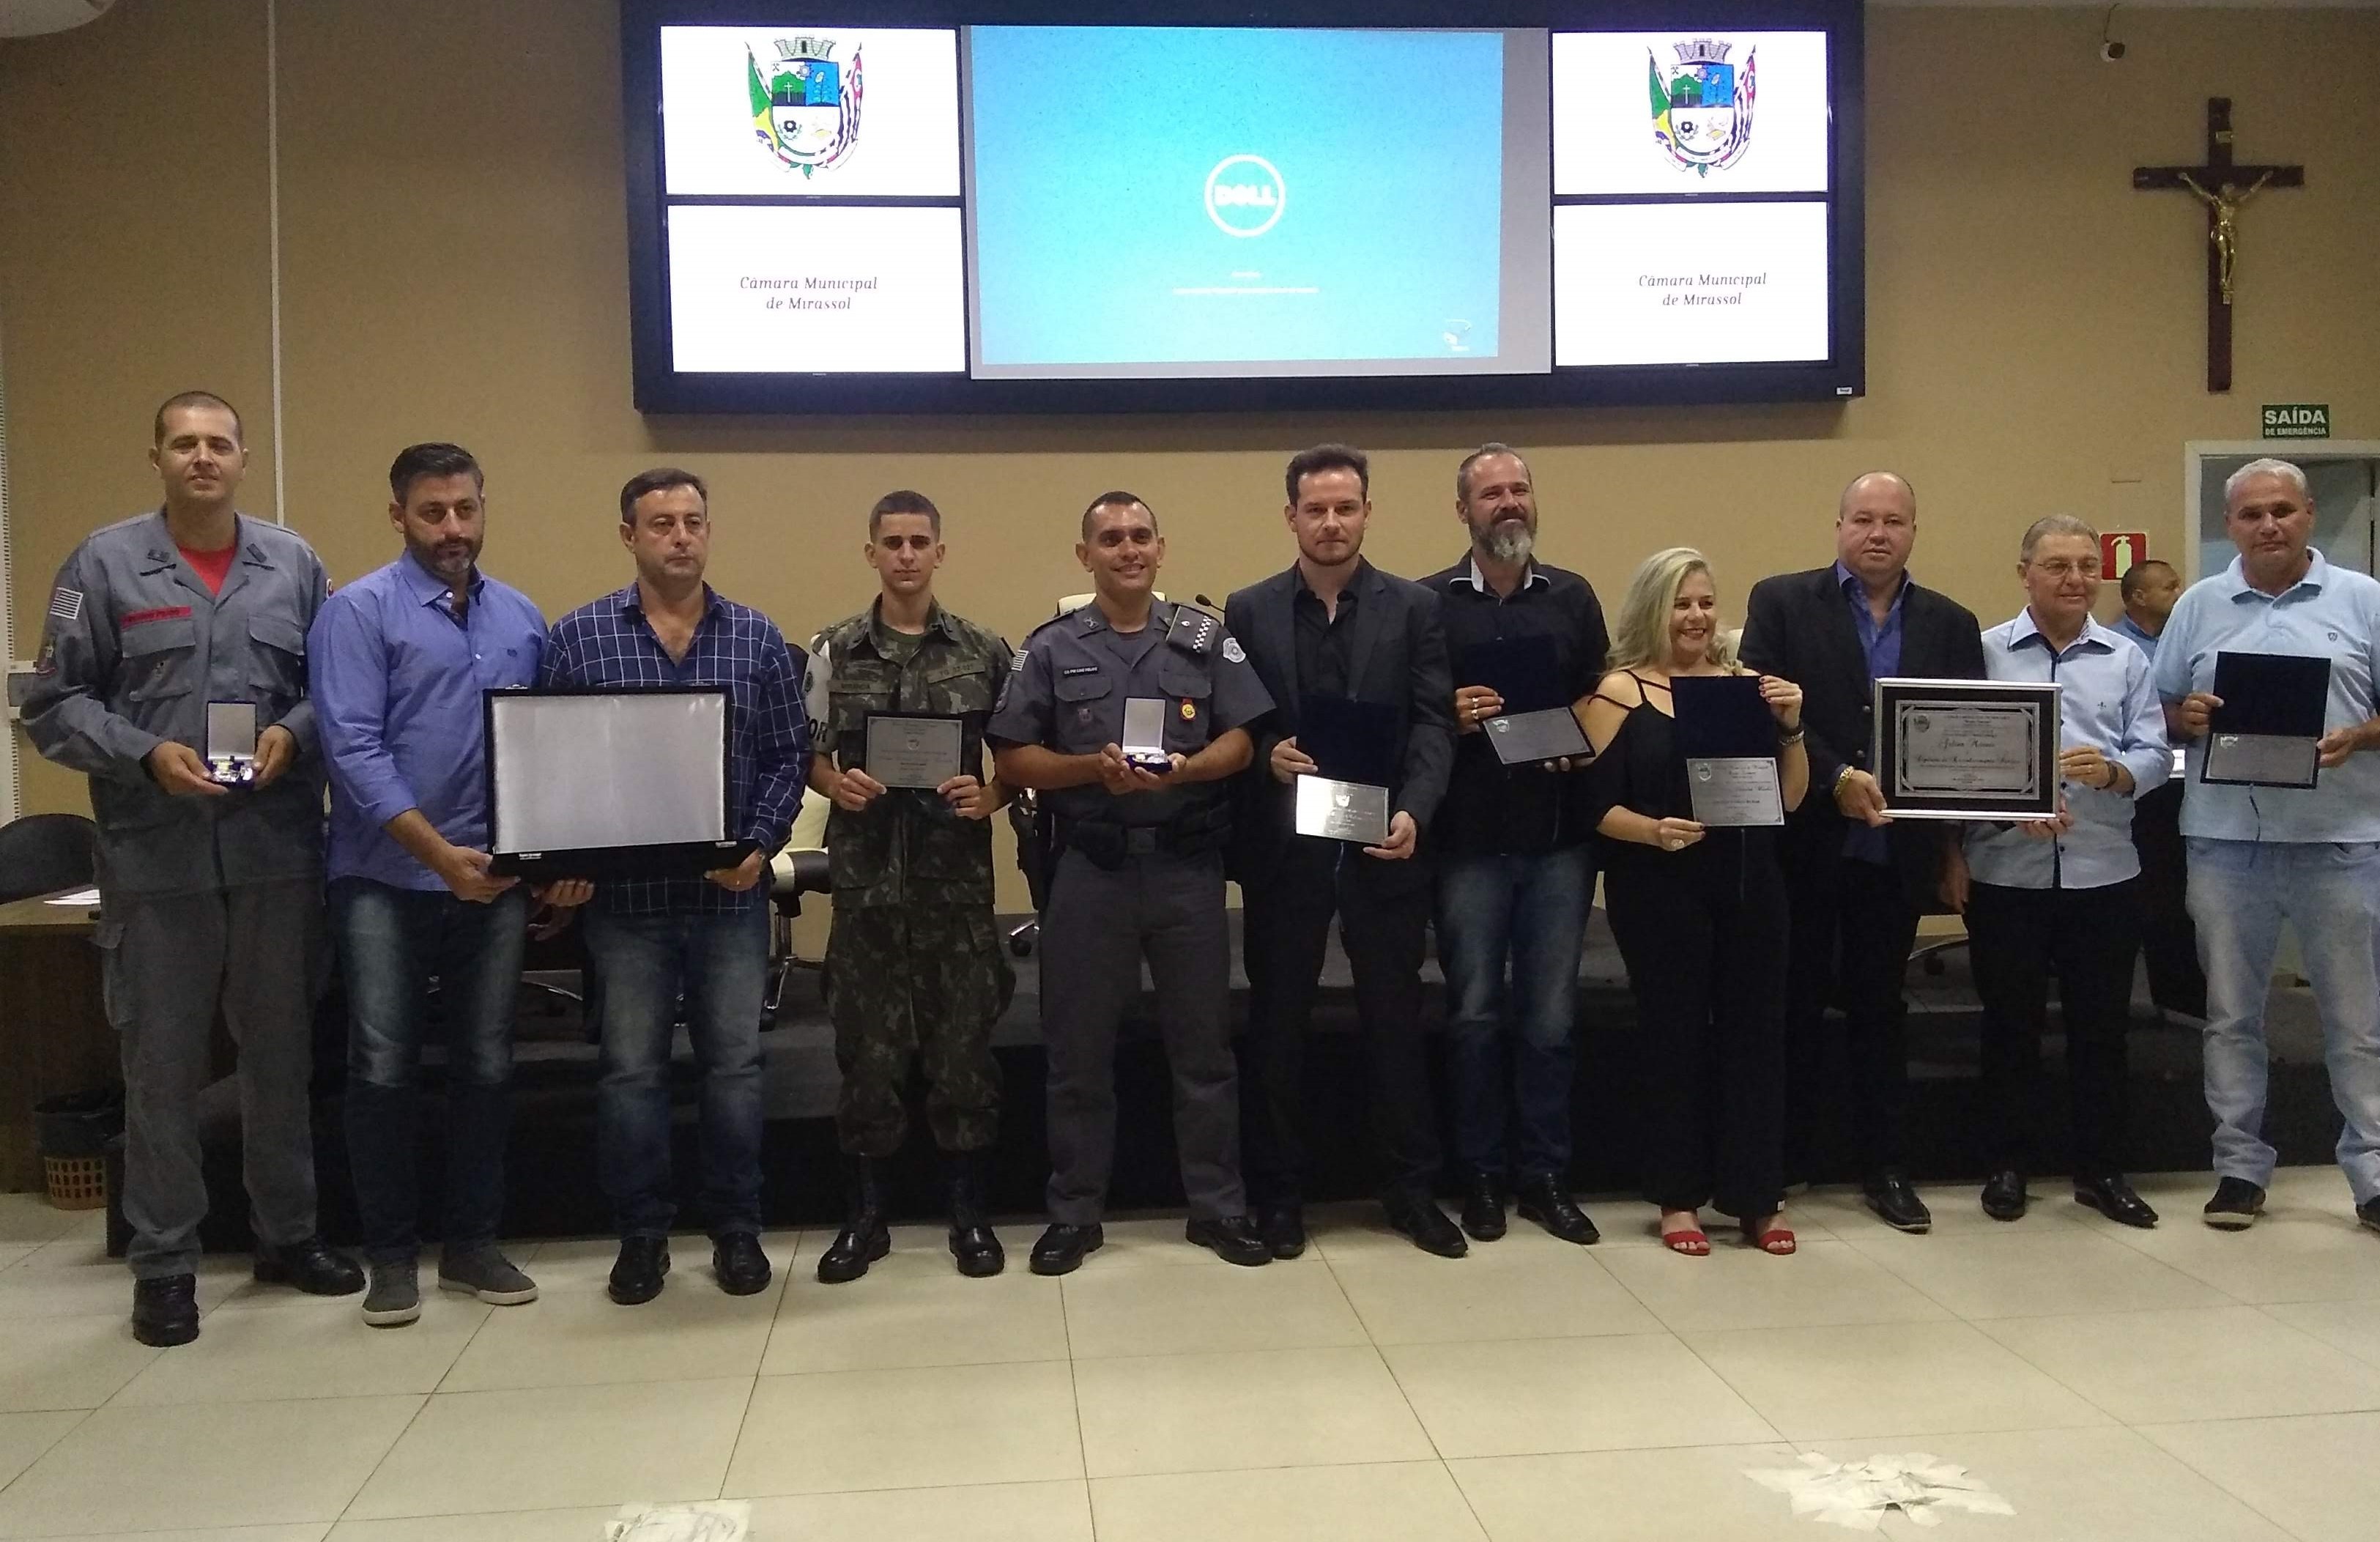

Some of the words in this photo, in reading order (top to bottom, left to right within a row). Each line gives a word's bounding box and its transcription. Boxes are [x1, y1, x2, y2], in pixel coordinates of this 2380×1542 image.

[740, 276, 798, 289] Câmara
[804, 276, 877, 292] Municipal
[1639, 275, 1693, 286] Câmara
[1699, 273, 1766, 289] Municipal
[766, 297, 783, 309] de
[788, 297, 850, 309] Mirassol
[1662, 294, 1678, 305] de
[1683, 292, 1741, 305] Mirassol
[2265, 407, 2326, 424] SAÍDA
[2265, 428, 2275, 436] DE
[2277, 426, 2327, 436] EMERGÊNCIA
